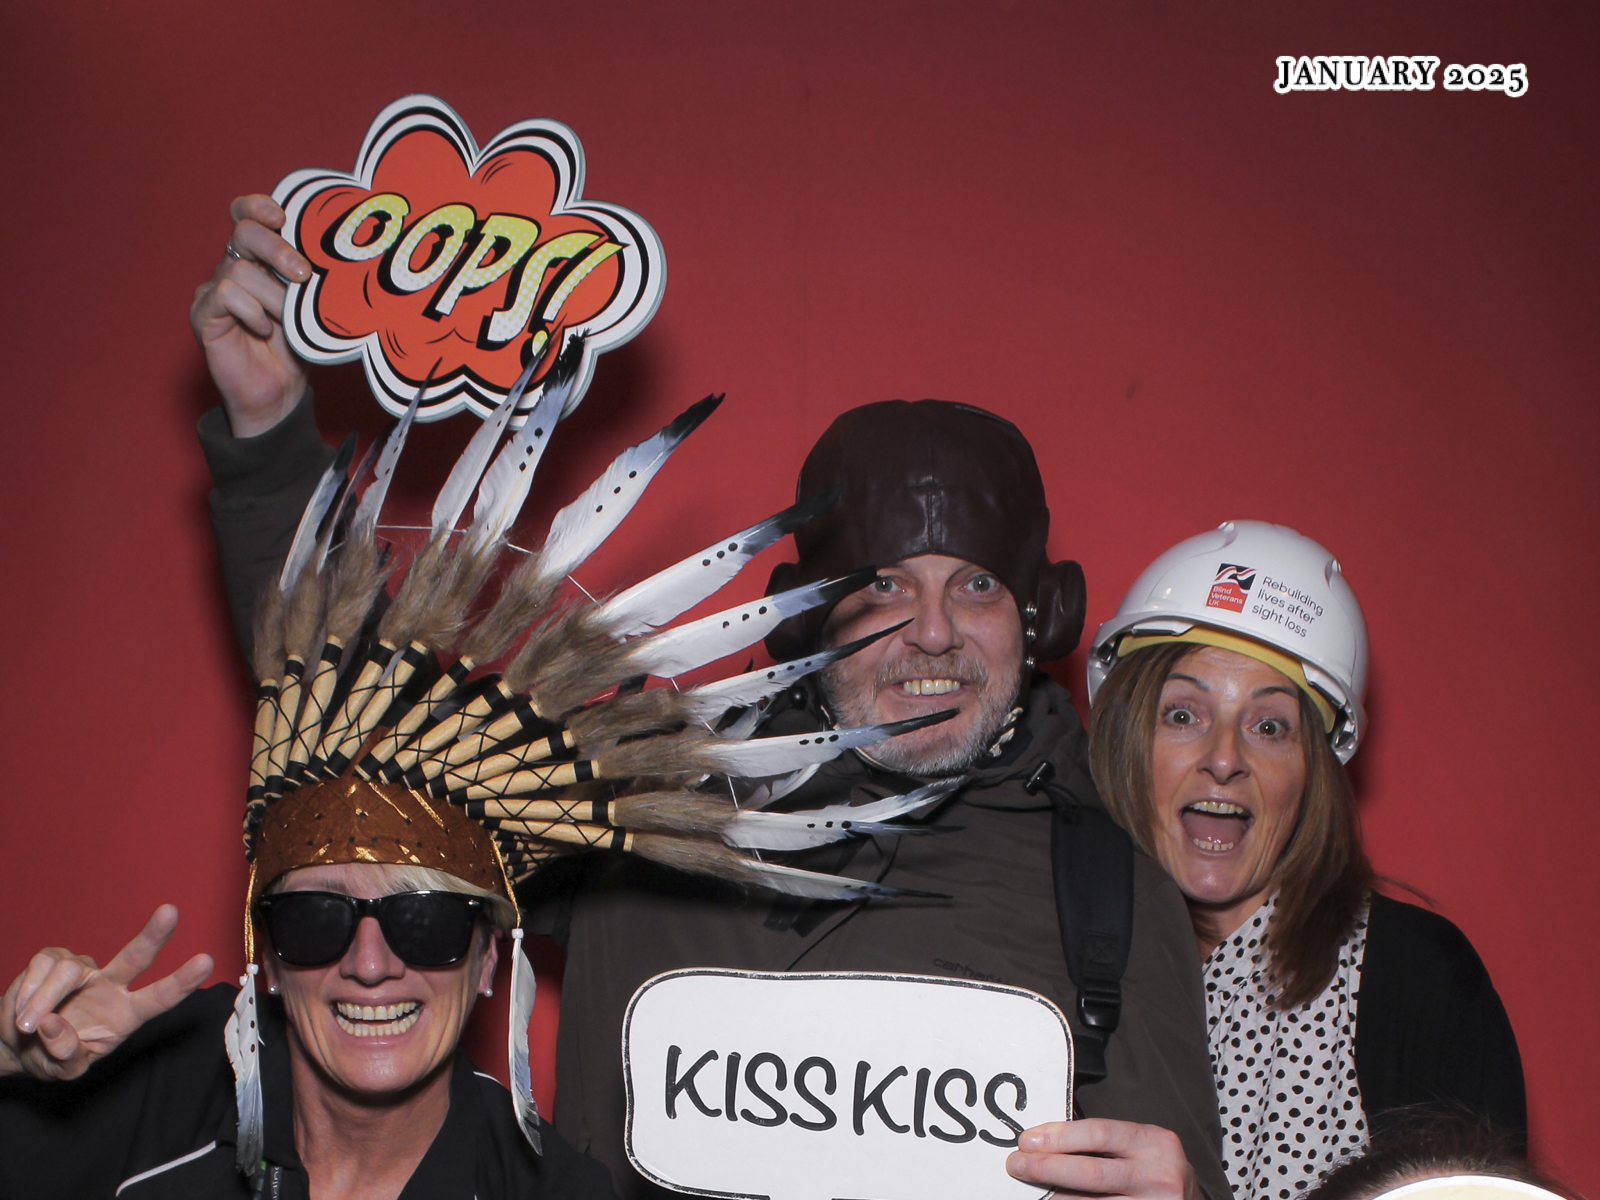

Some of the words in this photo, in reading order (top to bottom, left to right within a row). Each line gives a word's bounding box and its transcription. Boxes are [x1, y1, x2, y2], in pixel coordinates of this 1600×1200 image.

[322, 192, 630, 371] OOPS!
[1208, 599, 1220, 607] UK
[1211, 592, 1243, 605] Veterans
[1213, 586, 1233, 595] Blind
[1257, 588, 1286, 608] lives
[1287, 601, 1316, 625] after
[1262, 576, 1324, 617] Rebuilding
[1251, 604, 1284, 625] sight
[1284, 616, 1308, 638] loss
[932, 957, 1010, 985] carhar
[664, 1044, 838, 1132] KISS
[852, 1060, 1028, 1148] KISS
